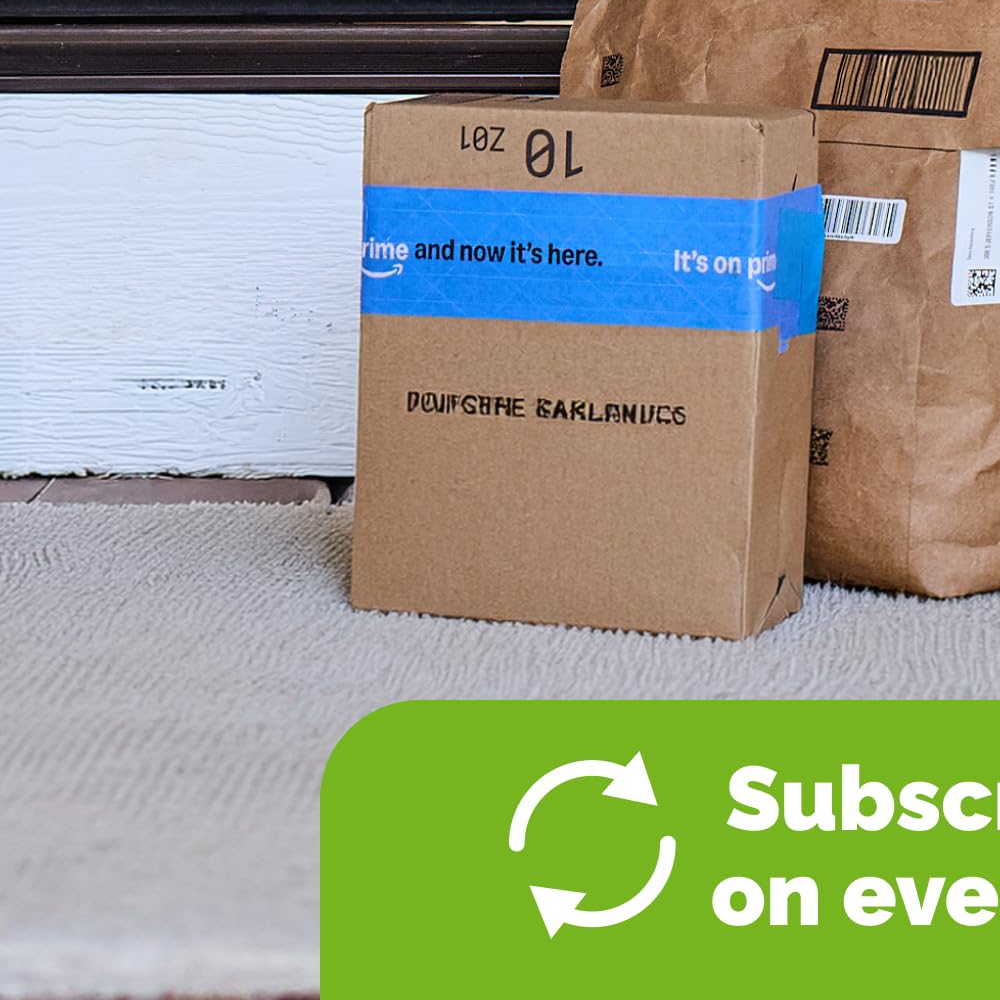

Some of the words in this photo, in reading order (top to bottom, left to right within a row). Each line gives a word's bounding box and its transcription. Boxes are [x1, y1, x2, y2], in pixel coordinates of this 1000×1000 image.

[525, 128, 584, 179] 10
[362, 237, 409, 261] rime
[414, 239, 455, 261] and
[459, 243, 506, 263] now
[510, 241, 543, 264] it's
[548, 243, 604, 268] here.
[674, 249, 709, 274] It's
[713, 255, 741, 274] on
